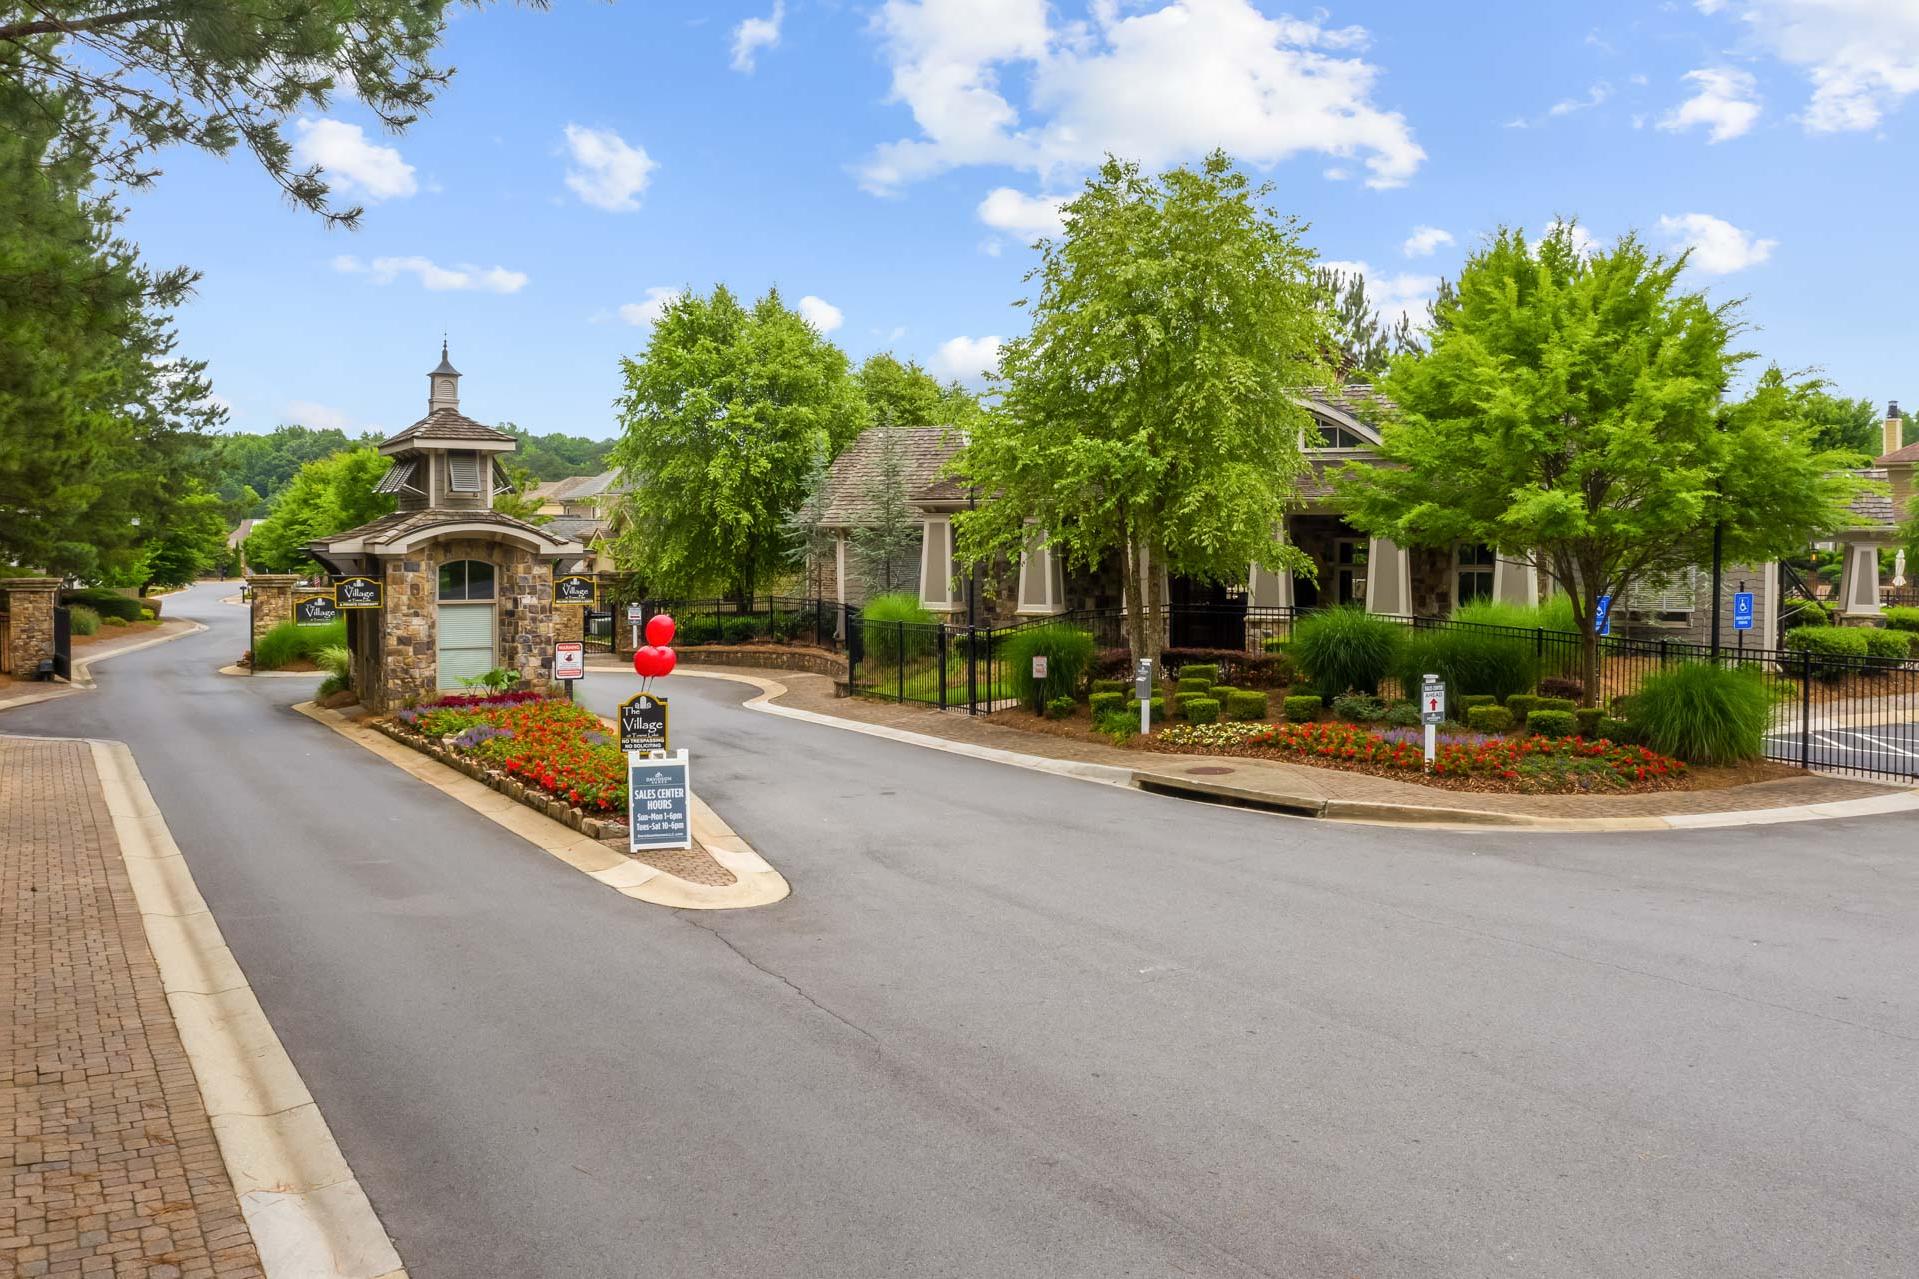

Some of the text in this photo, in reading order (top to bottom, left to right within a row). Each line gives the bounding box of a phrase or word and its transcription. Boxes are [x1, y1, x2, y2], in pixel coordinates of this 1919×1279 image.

[344, 588, 375, 600] Village
[562, 585, 589, 597] Village
[305, 607, 336, 618] Village
[623, 706, 641, 716] The
[623, 717, 663, 733] Village
[634, 788, 685, 800] SALES CENTER
[647, 800, 673, 810] HOURS
[637, 811, 683, 822] Sun-Mon 1-6pm
[636, 821, 685, 831] Tues-Sat 10-6pm
